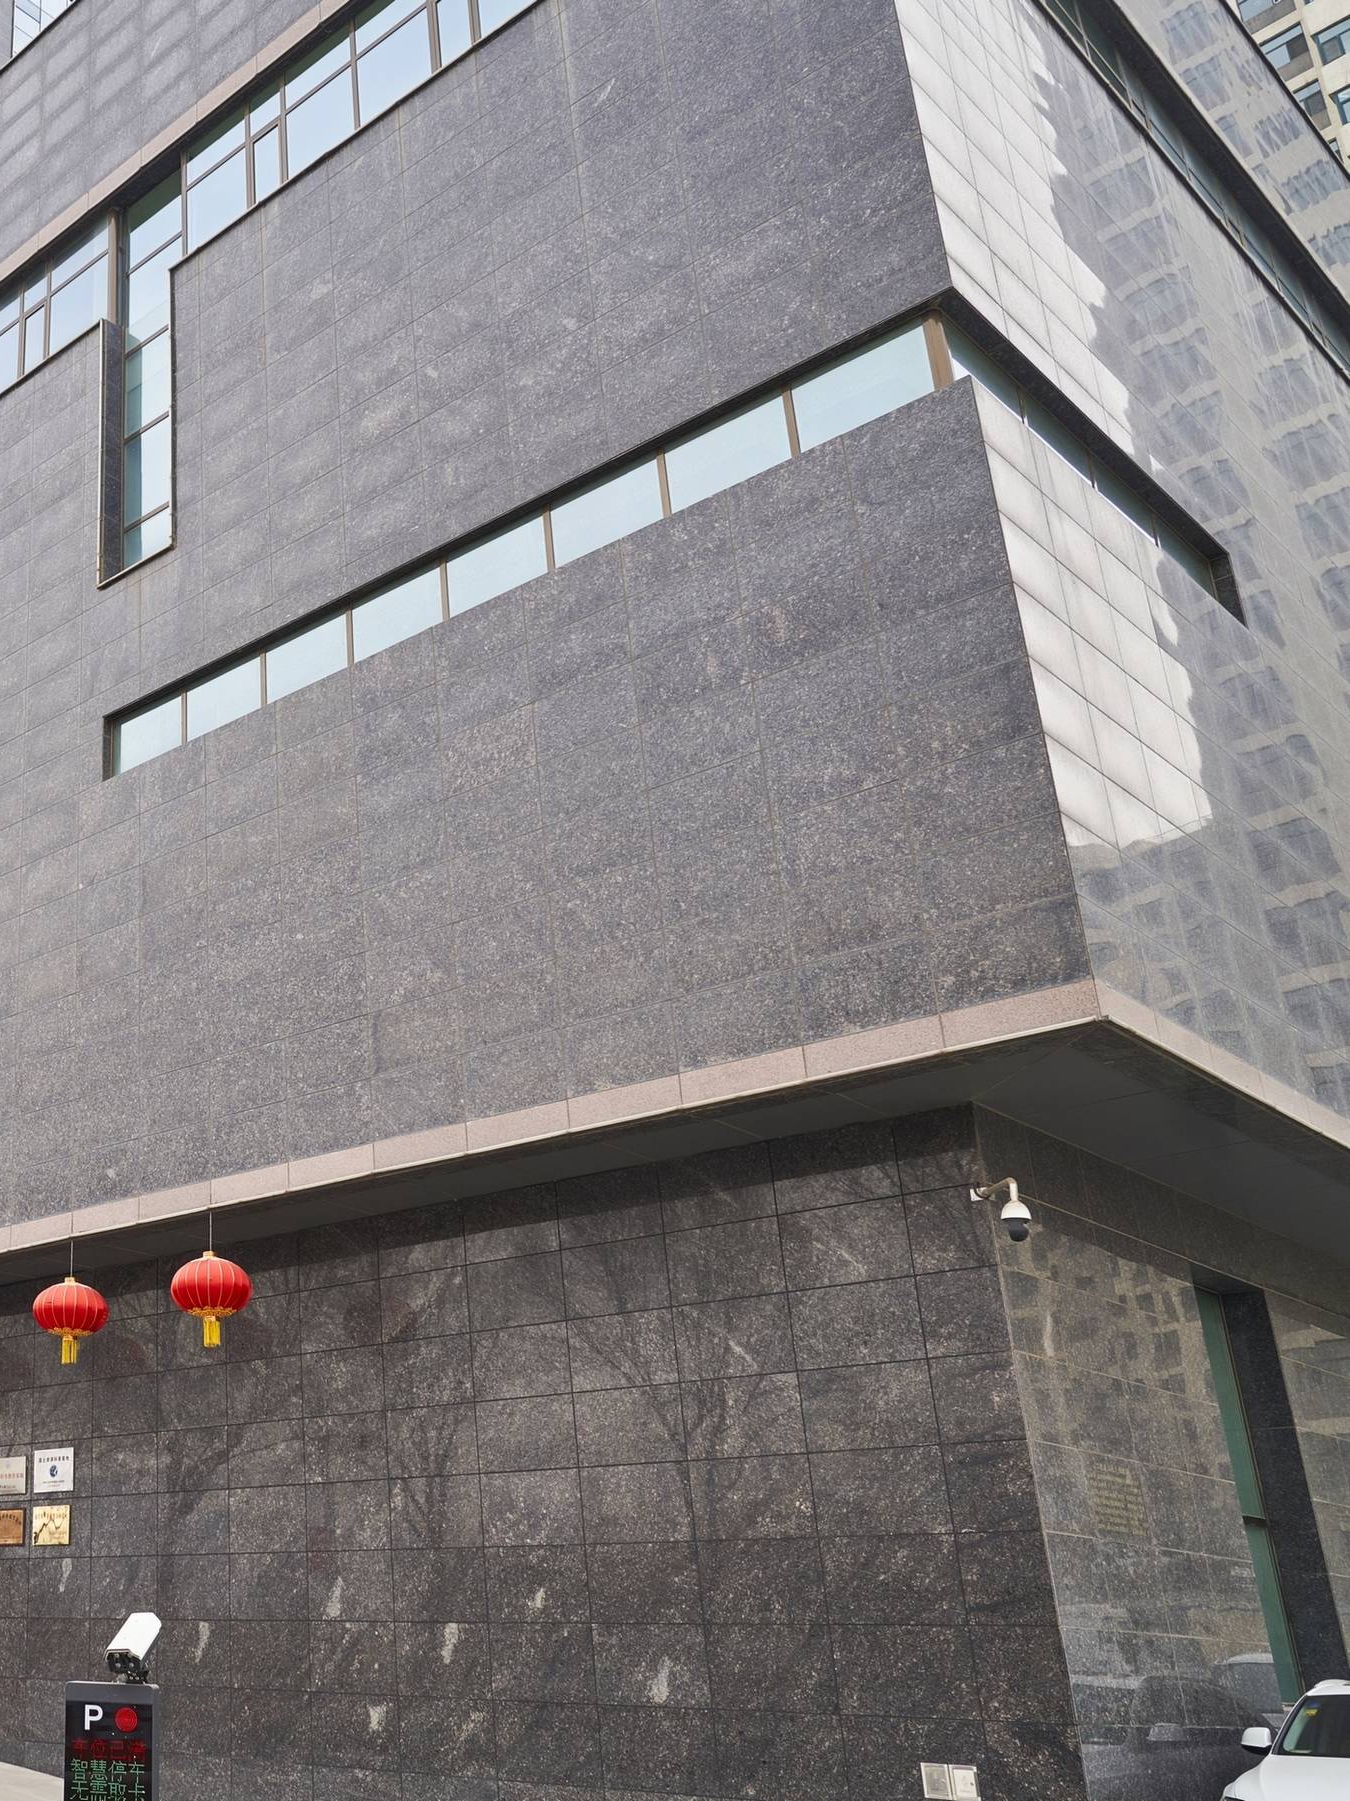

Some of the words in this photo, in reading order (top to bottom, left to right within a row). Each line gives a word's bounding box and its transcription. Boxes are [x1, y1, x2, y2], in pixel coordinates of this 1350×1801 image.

[84, 1704, 103, 1731] P
[70, 1758, 146, 1784] 智慧停车
